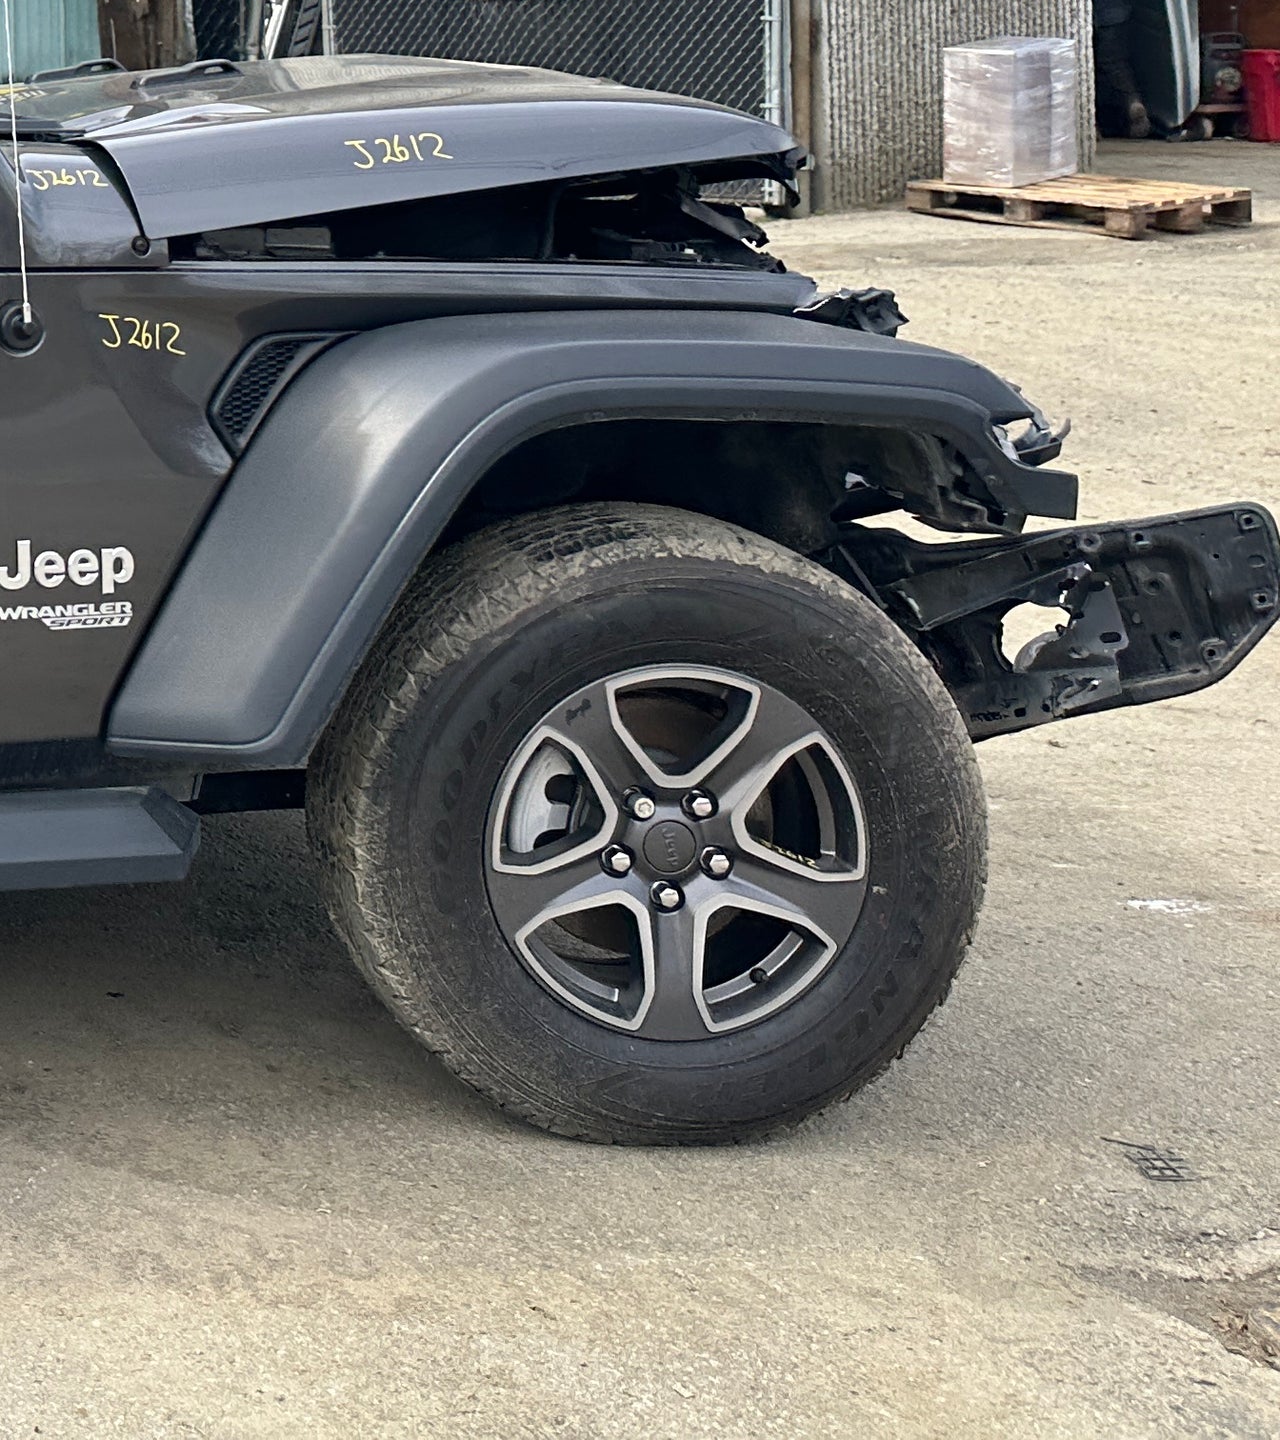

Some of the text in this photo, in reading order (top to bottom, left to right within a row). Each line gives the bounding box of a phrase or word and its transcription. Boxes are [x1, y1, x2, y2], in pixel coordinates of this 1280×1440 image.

[344, 131, 454, 171] J2612
[24, 168, 110, 193] J2612
[98, 313, 187, 356] J2612
[48, 616, 128, 628] SPORT
